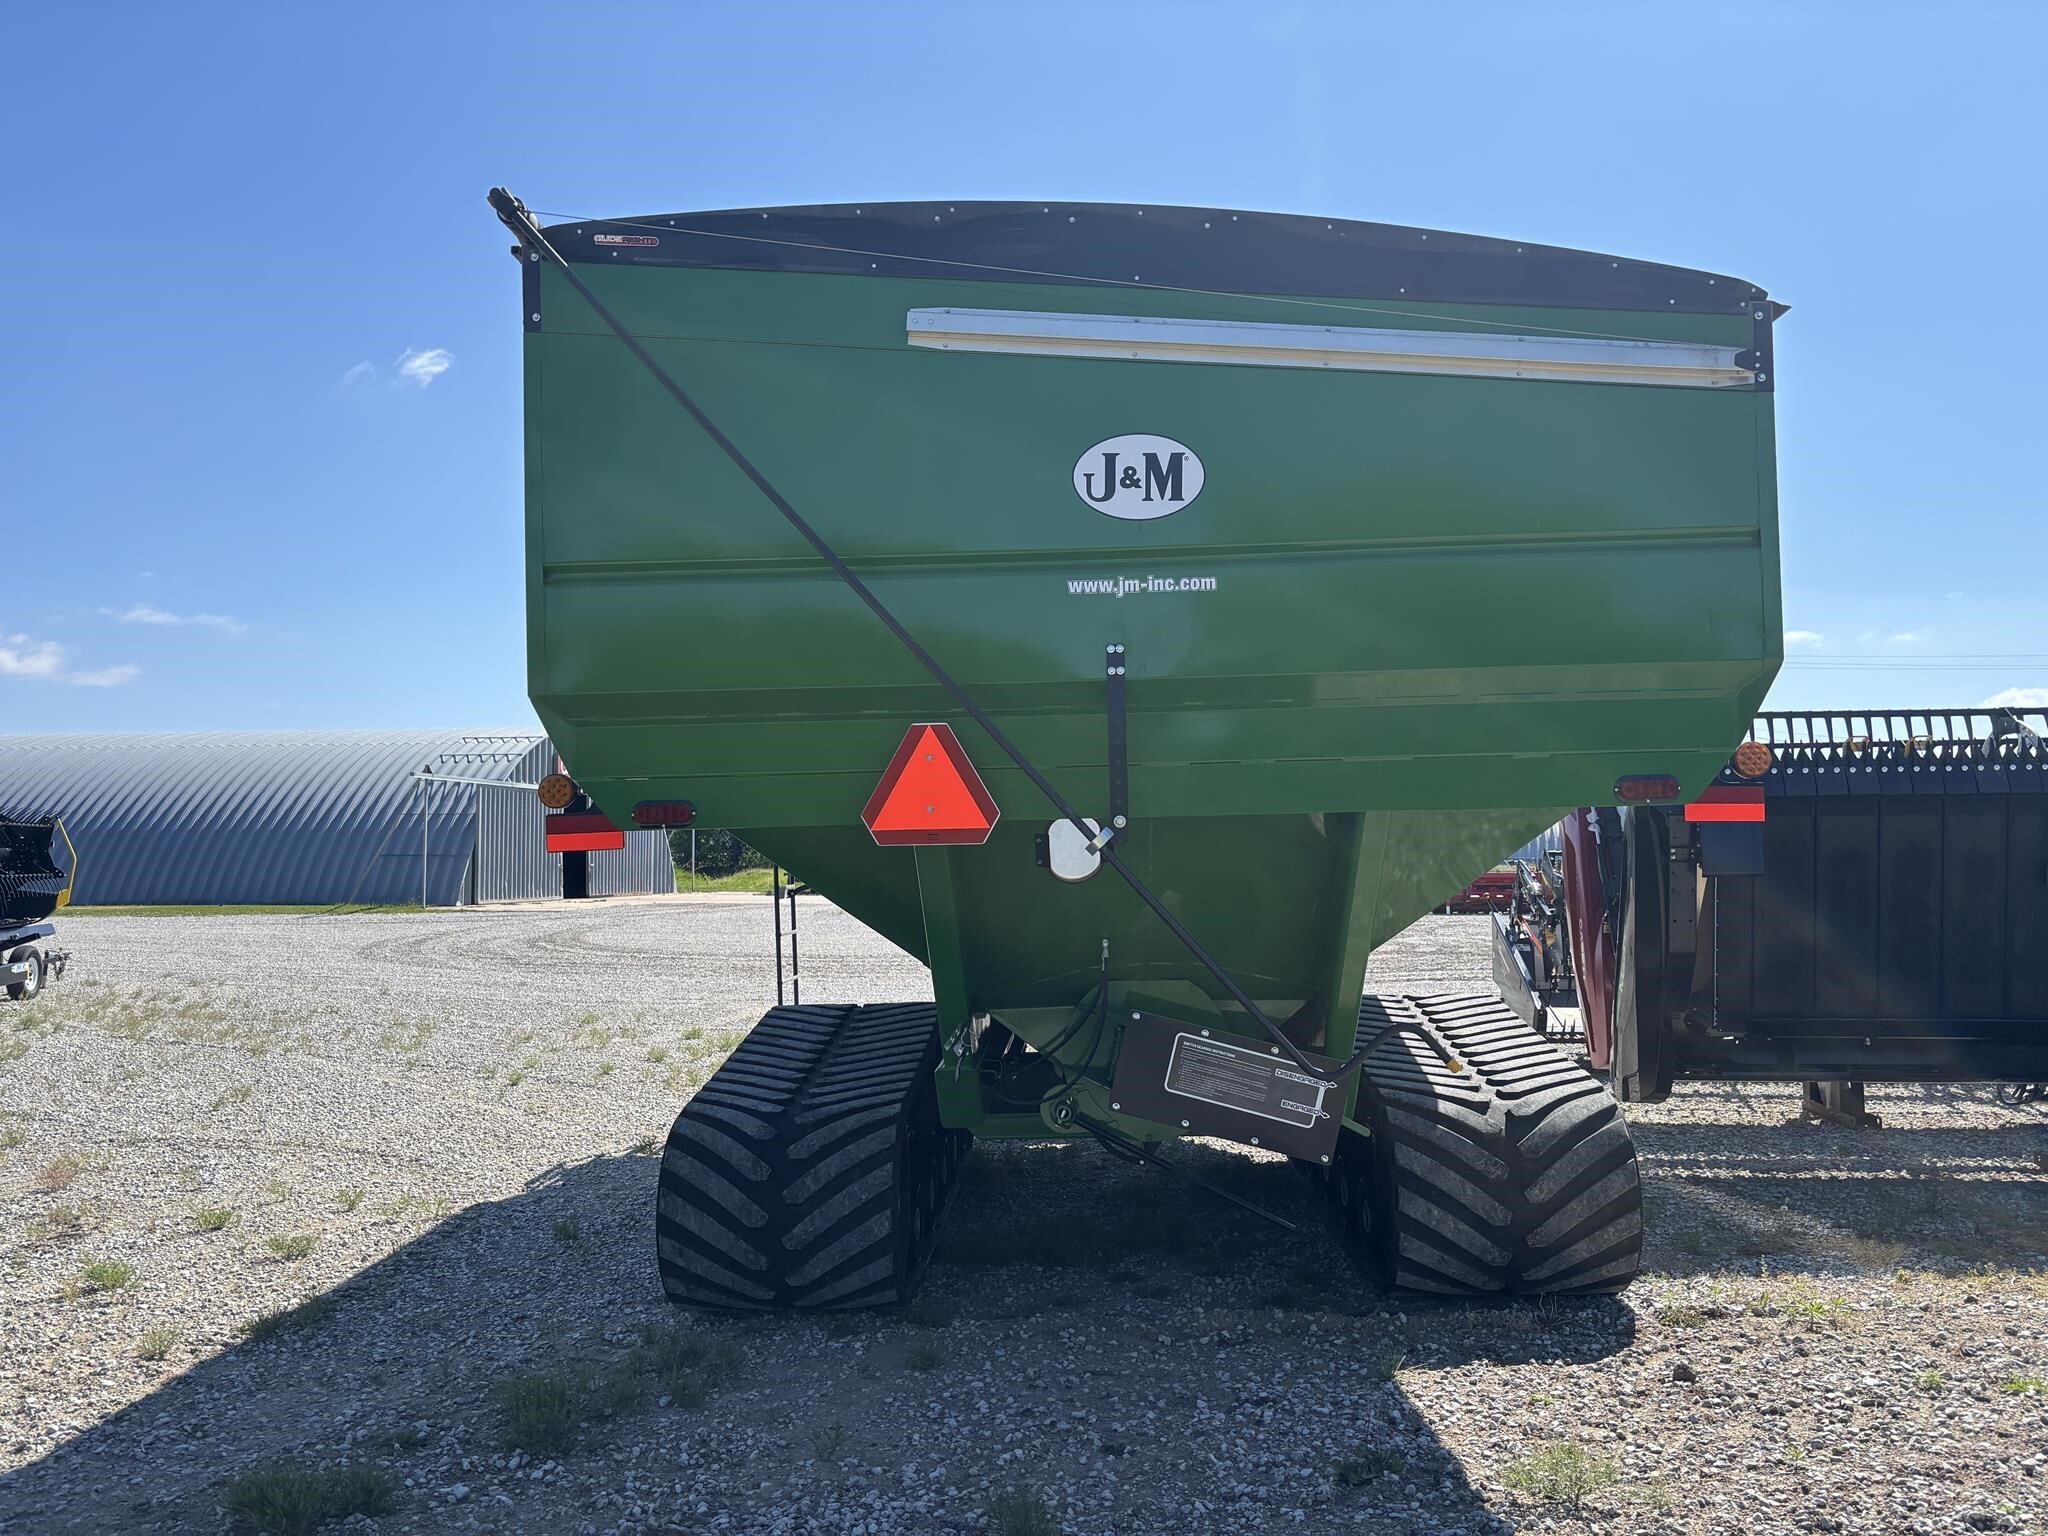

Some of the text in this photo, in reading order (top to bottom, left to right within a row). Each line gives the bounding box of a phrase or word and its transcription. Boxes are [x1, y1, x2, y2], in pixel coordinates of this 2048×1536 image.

[1083, 452, 1186, 503] J&M
[1067, 576, 1217, 598] www.jm-inc.com
[1276, 1069, 1327, 1088] DISENGAGED
[1282, 1101, 1320, 1115] ENGAGED
